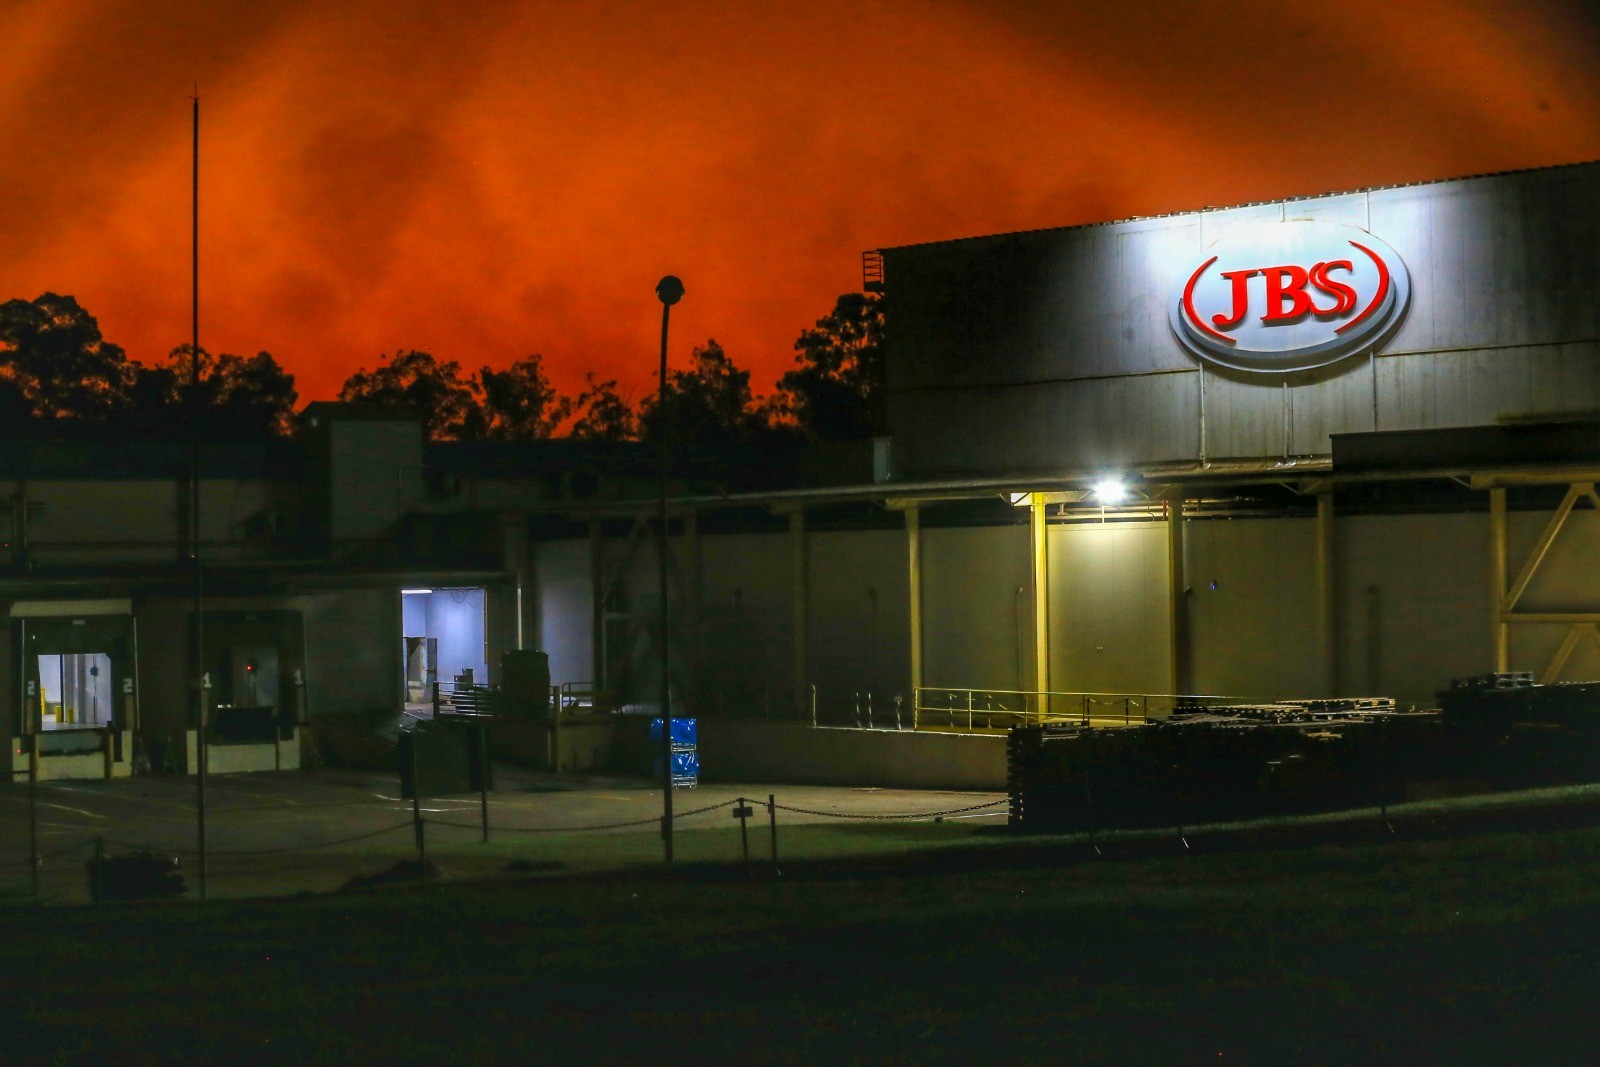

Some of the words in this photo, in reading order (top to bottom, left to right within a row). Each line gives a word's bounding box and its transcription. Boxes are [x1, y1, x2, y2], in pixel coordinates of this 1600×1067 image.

[1212, 260, 1357, 327] JBS
[203, 671, 212, 688] 1
[294, 669, 304, 685] 1
[28, 680, 35, 696] 2
[123, 678, 133, 693] 2
